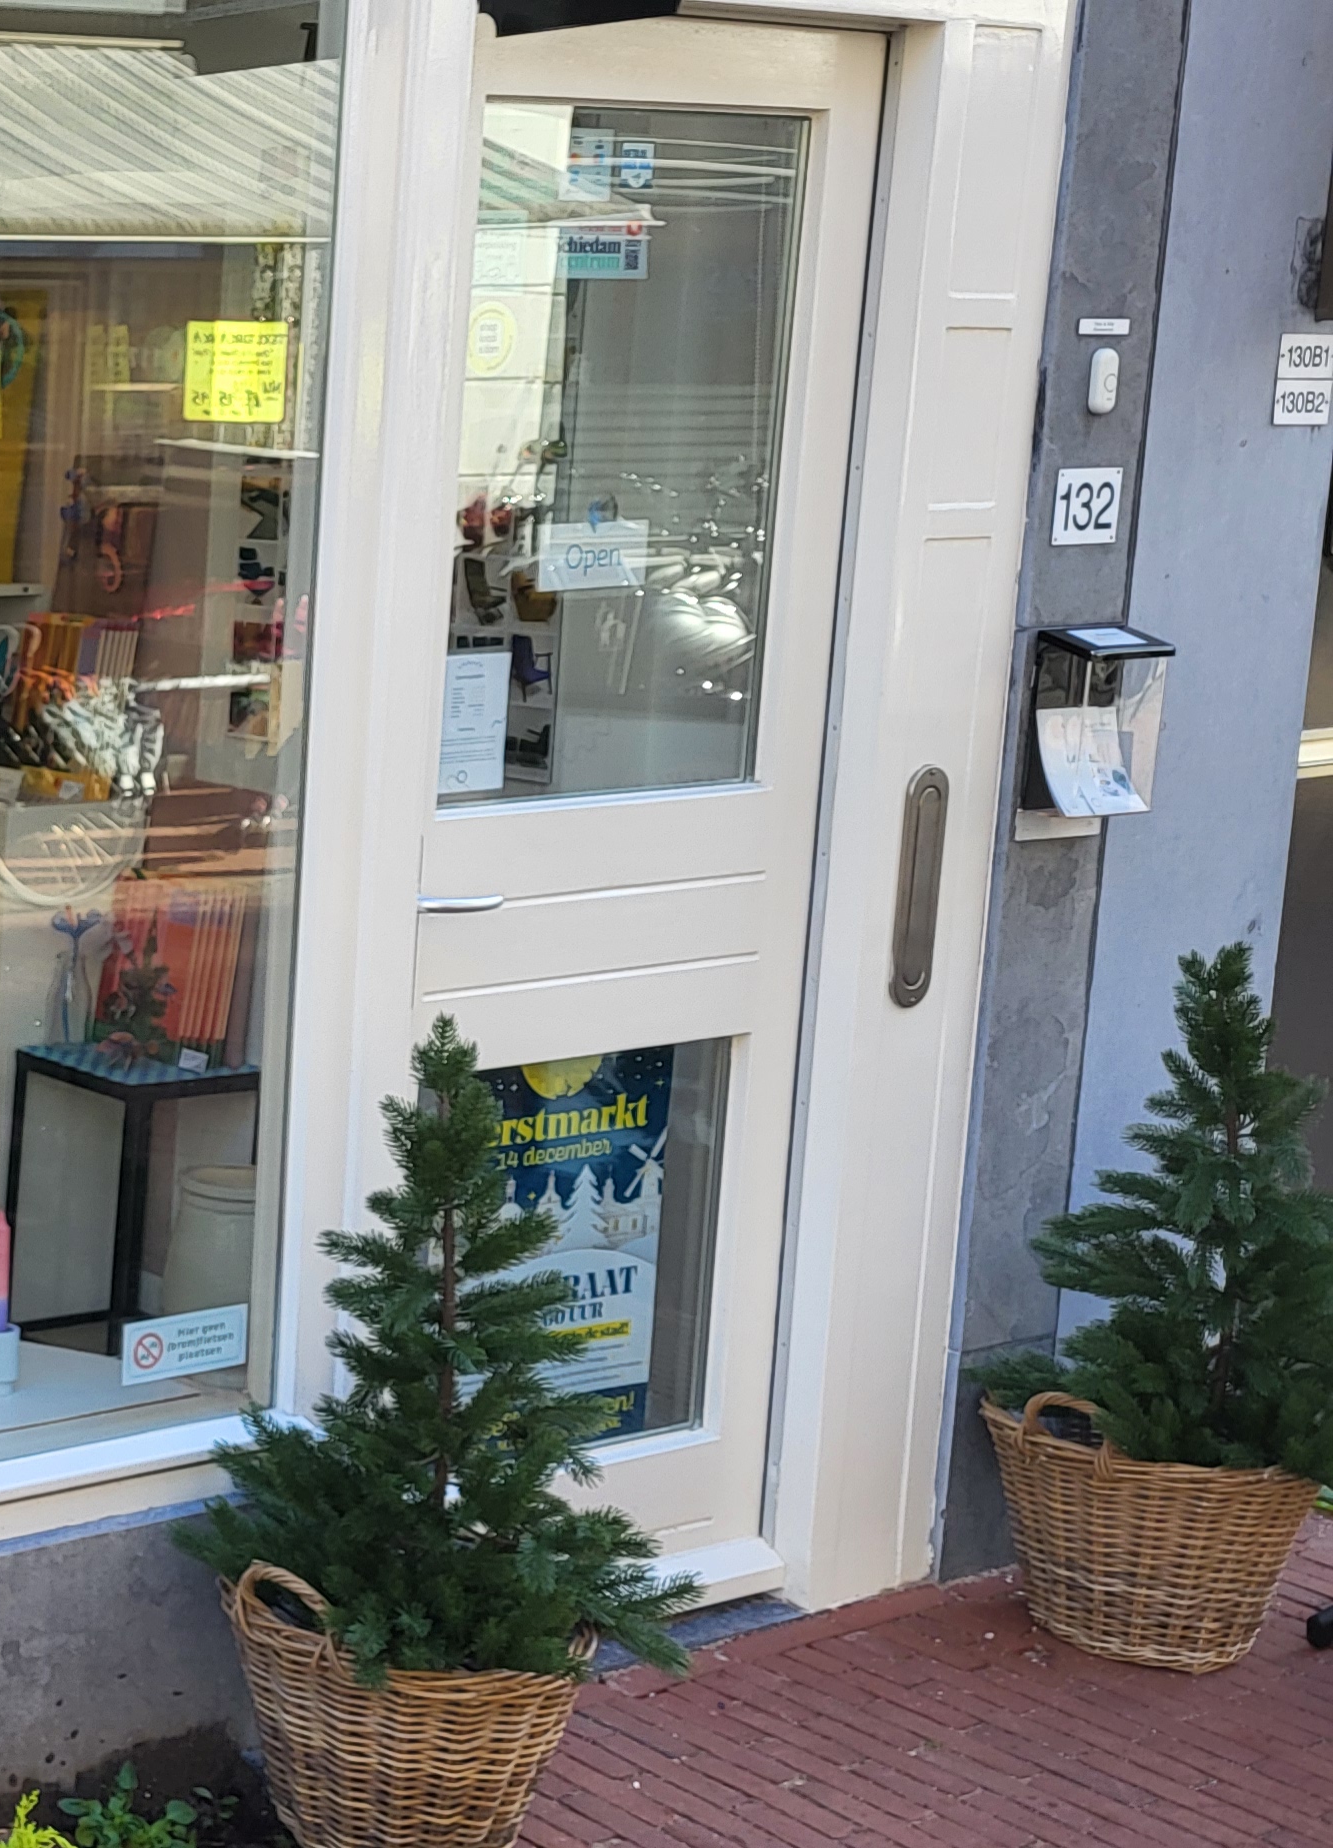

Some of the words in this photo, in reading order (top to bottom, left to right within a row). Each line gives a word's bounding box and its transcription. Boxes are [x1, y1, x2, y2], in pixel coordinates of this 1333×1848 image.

[1287, 345, 1330, 368] 130B1
[1280, 391, 1325, 414] 130B2
[1059, 481, 1116, 532] 132
[565, 543, 623, 576] Open
[487, 1092, 649, 1147] erstmarkt
[523, 1138, 613, 1167] december
[177, 1326, 200, 1337] Hier
[202, 1322, 226, 1336] geen
[178, 1346, 223, 1363] plaatsen
